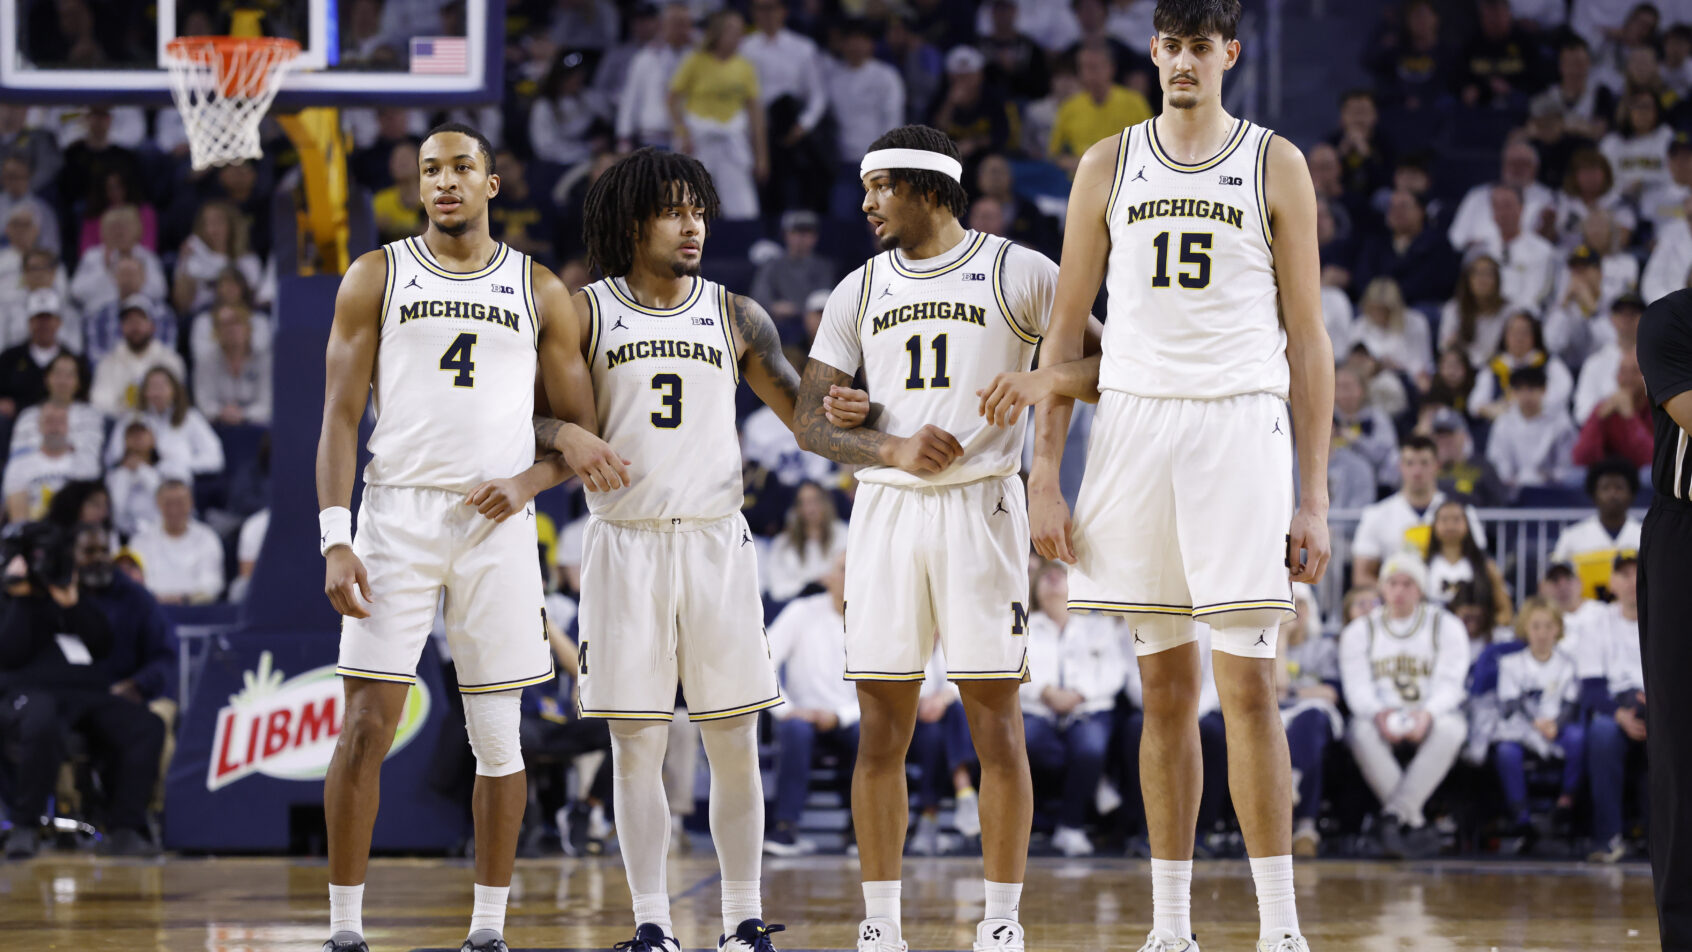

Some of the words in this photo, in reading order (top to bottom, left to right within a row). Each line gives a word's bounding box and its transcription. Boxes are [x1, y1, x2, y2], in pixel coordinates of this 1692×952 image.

[1127, 199, 1244, 229] MICHIGAN
[1152, 231, 1213, 289] 15
[400, 300, 520, 332] MICHIGAN
[872, 301, 987, 336] MICHIGAN
[439, 332, 478, 388] 4
[606, 340, 723, 370] MICHIGAN
[905, 333, 951, 390] 11
[650, 373, 683, 429] 3
[217, 697, 346, 778] LIBM
